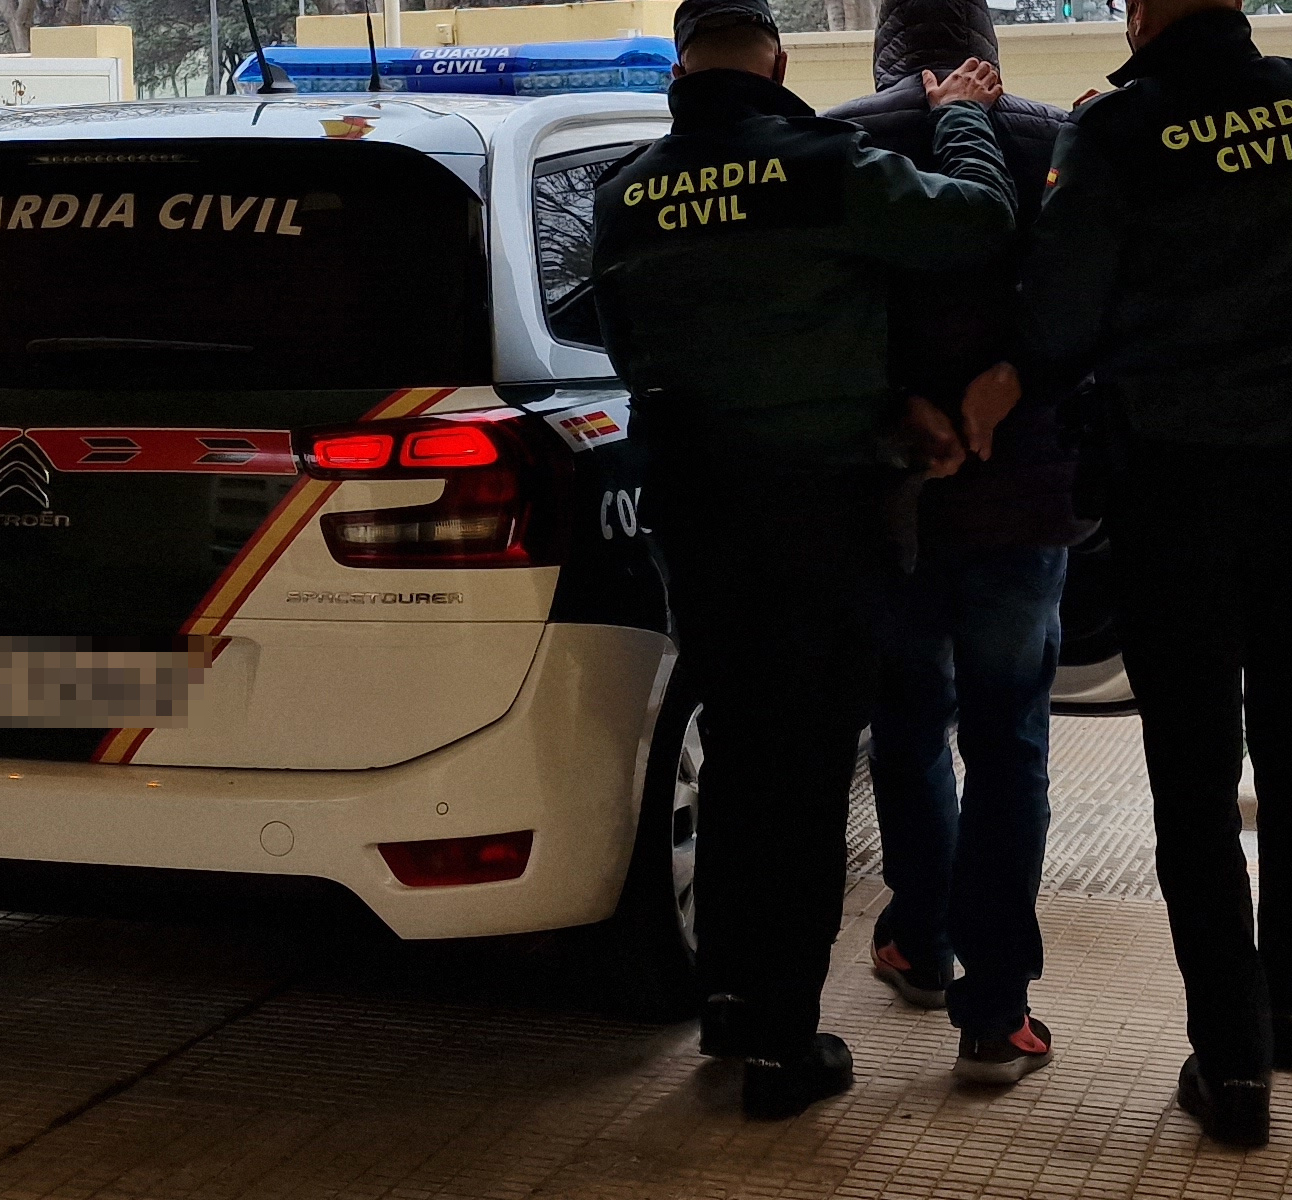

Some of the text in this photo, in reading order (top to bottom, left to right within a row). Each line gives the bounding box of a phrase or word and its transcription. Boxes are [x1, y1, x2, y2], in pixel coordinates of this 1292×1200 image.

[419, 47, 509, 59] GUARDIA
[433, 60, 487, 74] CIVIL
[623, 157, 788, 207] GUARDIA
[157, 193, 304, 236] CIVIL
[657, 194, 748, 231] CIVIL
[286, 591, 464, 605] SPACETOURER
